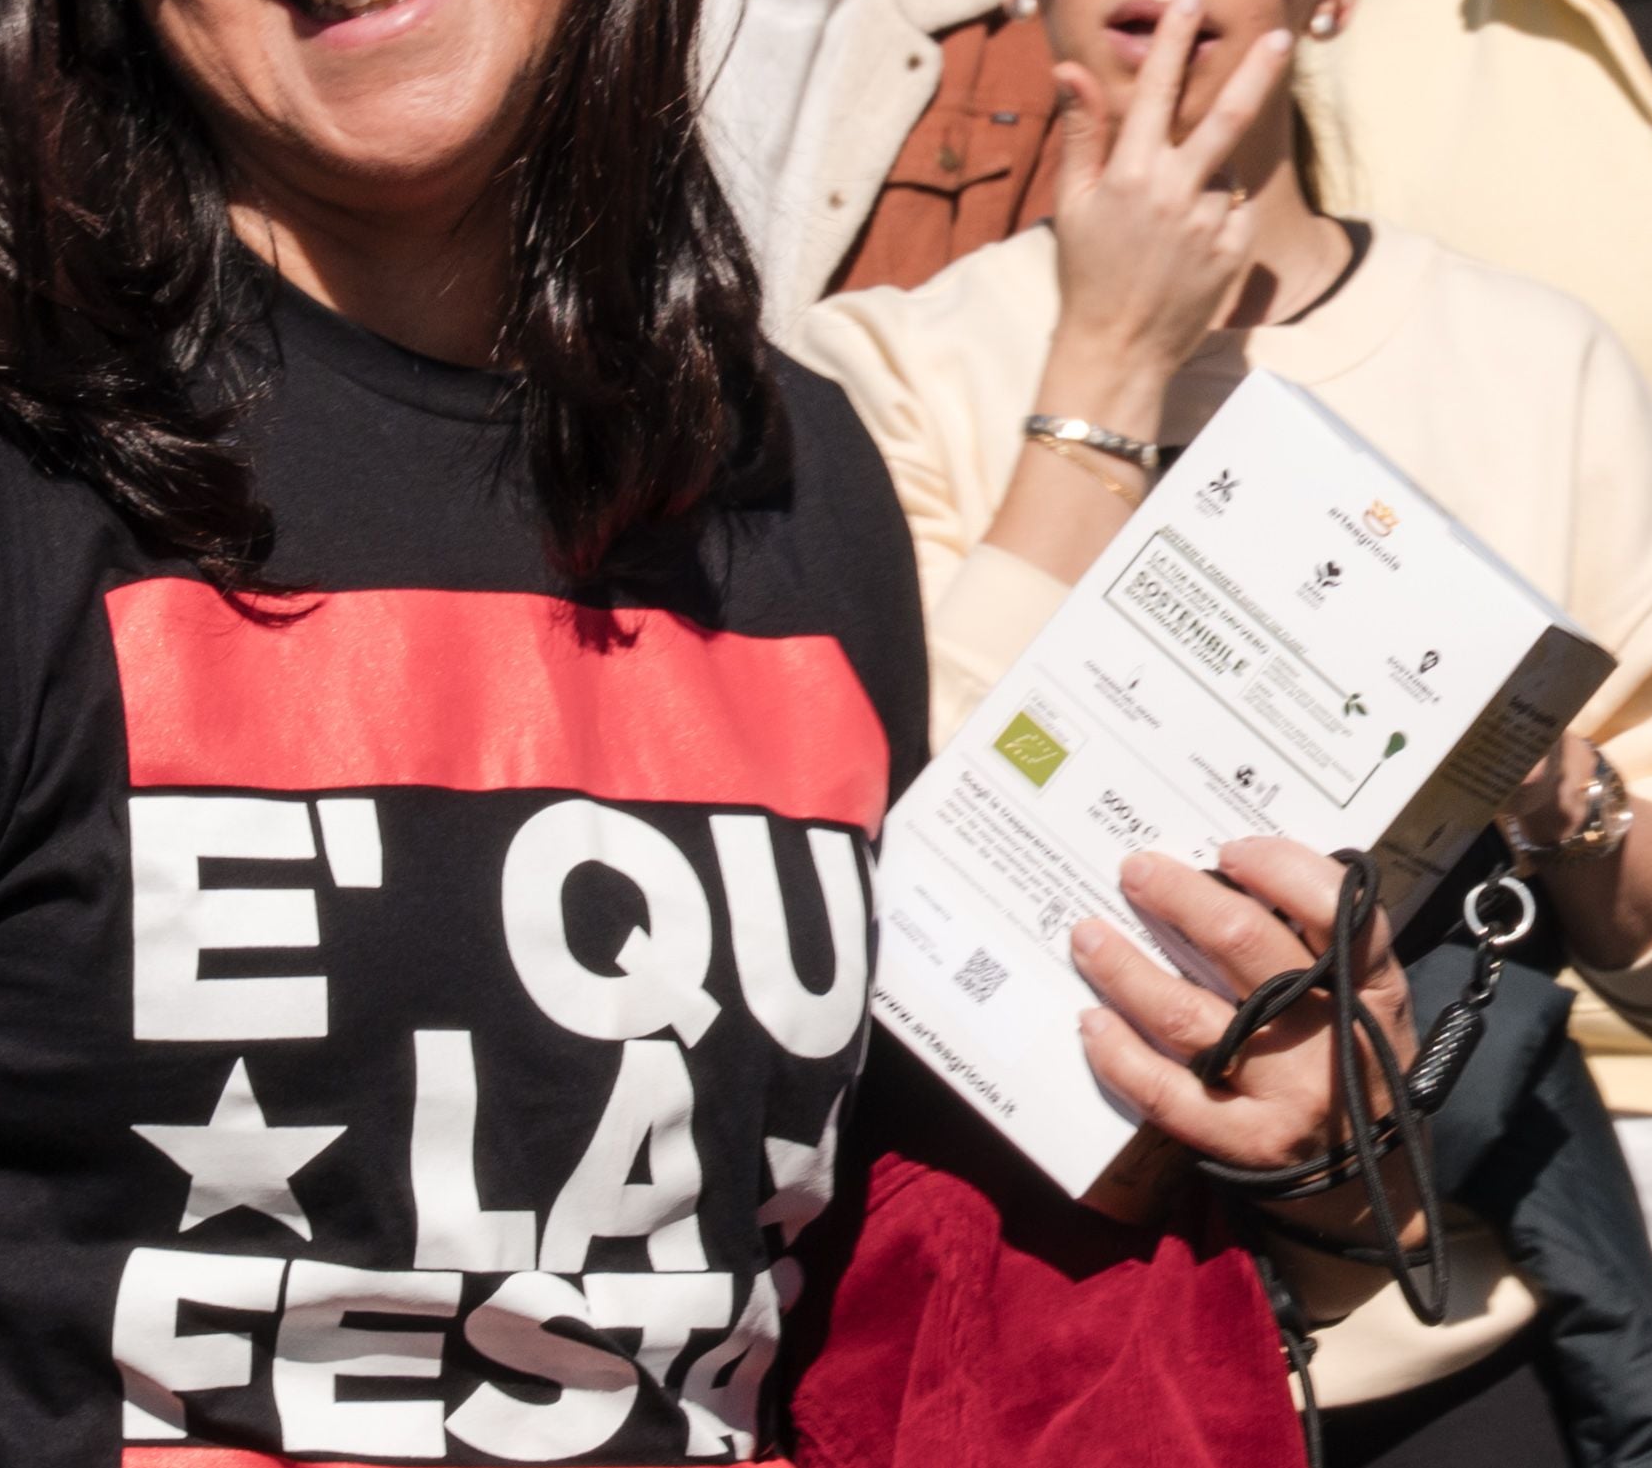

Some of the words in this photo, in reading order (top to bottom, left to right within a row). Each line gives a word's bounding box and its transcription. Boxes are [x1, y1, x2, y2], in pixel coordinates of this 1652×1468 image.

[1130, 568, 1251, 678] SOSTENIBILE
[1097, 786, 1136, 823] 500
[128, 795, 384, 1042] E'
[501, 798, 878, 1061] QU
[869, 985, 1021, 1122] www.arteagricola.it
[410, 1029, 709, 1273] LA
[112, 1246, 798, 1462] FESTA
